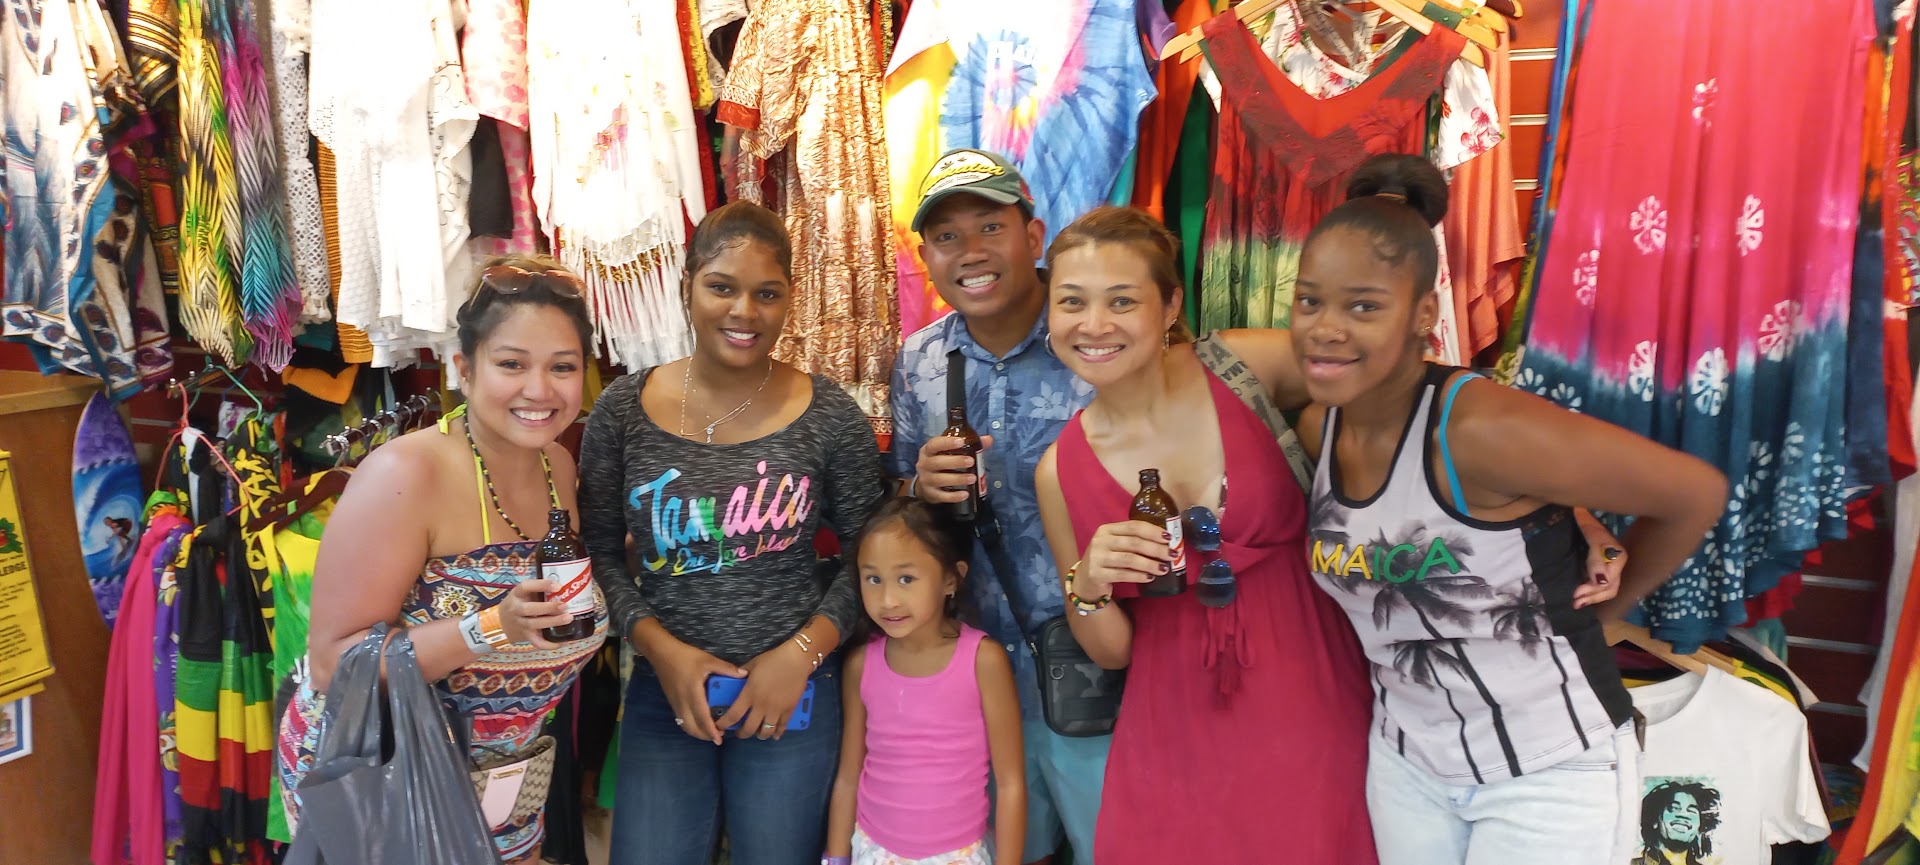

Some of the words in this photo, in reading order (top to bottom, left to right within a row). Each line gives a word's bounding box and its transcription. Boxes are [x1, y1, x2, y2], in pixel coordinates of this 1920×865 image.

[629, 460, 814, 571] Jamaica
[673, 547, 705, 573] One
[711, 541, 747, 575] Love
